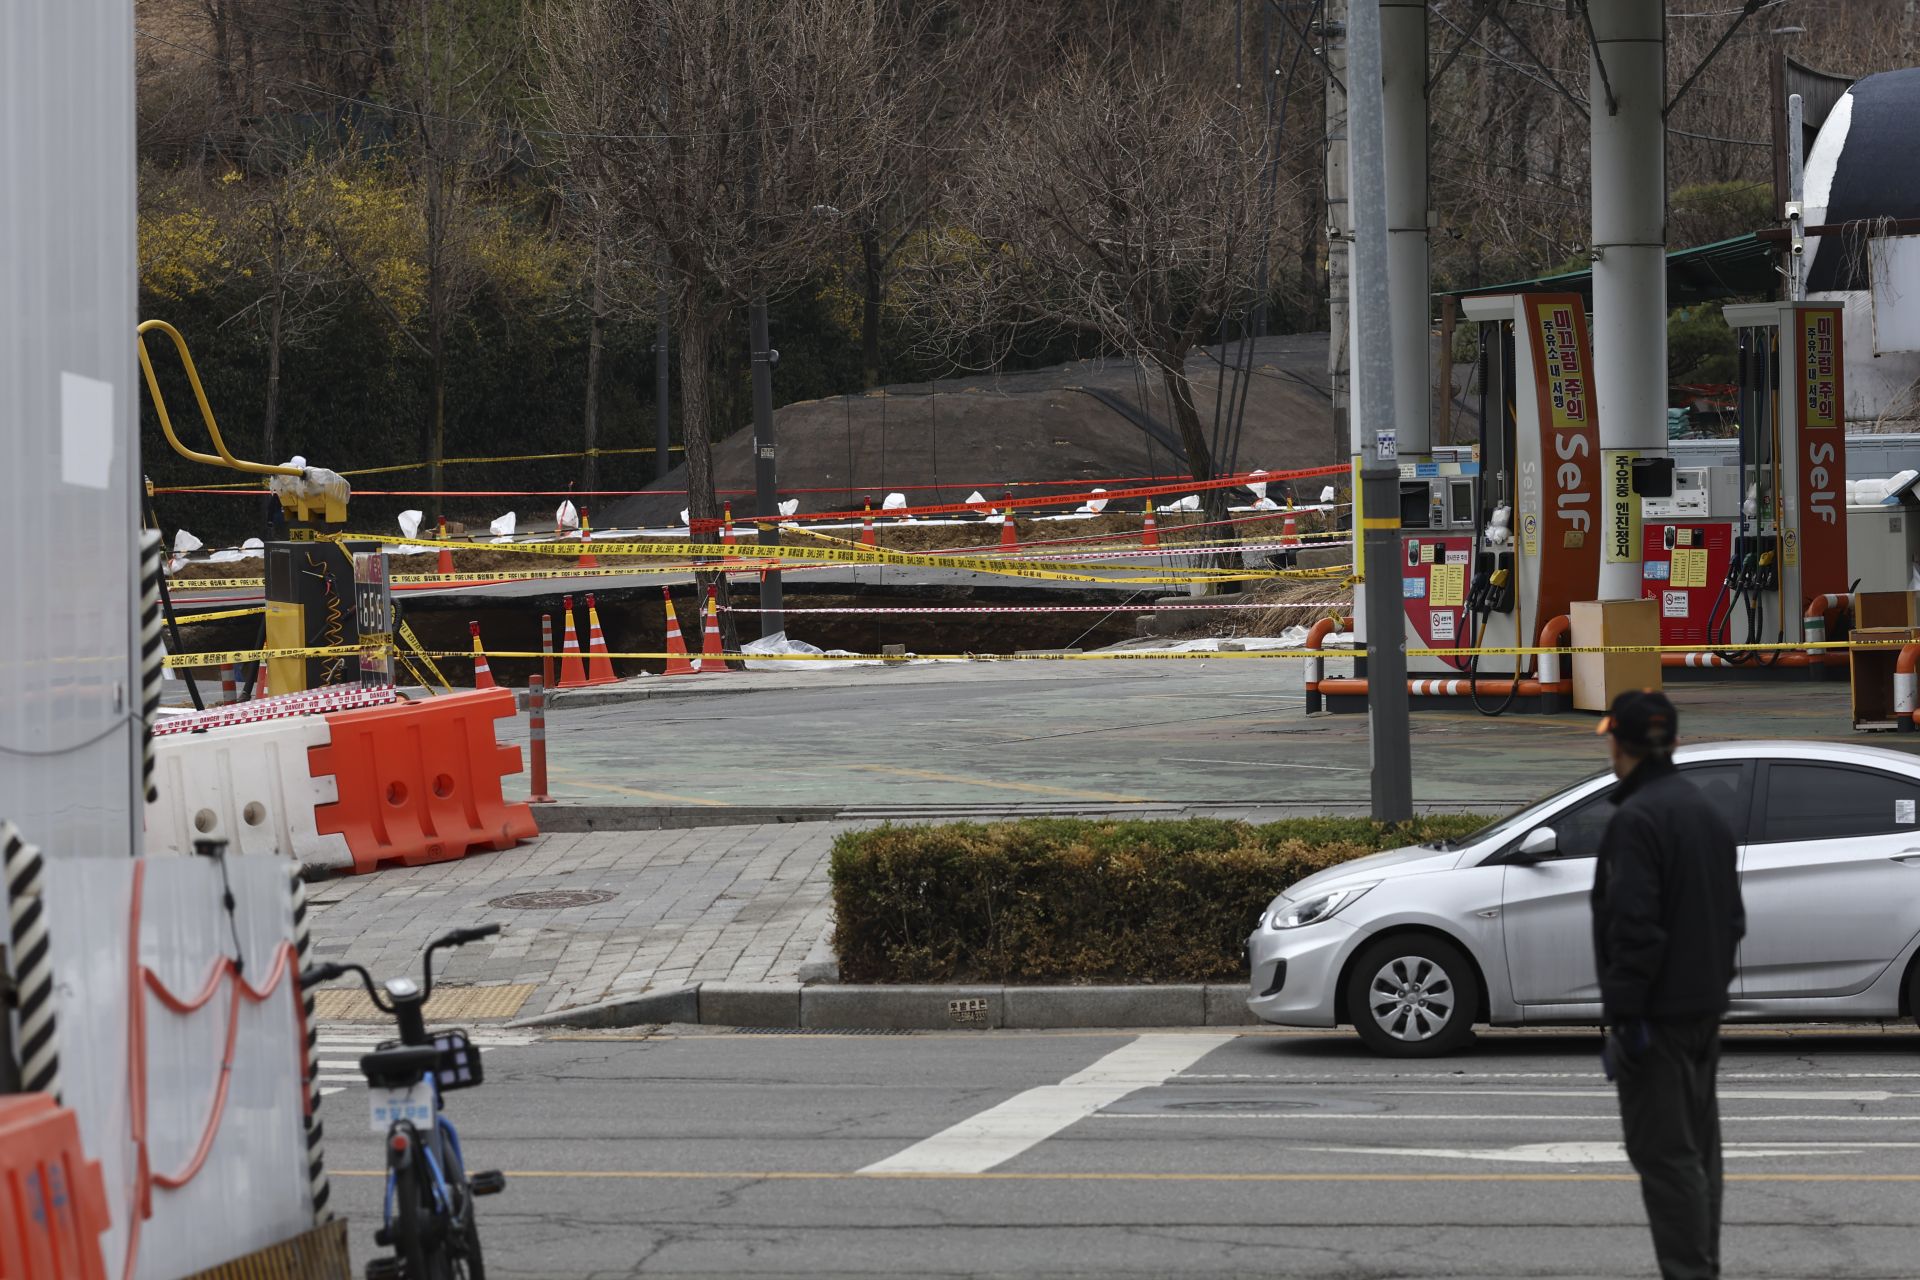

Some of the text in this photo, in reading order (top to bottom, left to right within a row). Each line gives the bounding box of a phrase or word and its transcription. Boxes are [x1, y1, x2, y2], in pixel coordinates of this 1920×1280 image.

[1543, 320, 1564, 409] 주유소 내 서행
[1553, 310, 1584, 420] 미끄럼 주의
[1807, 327, 1817, 364] 주유소
[1808, 368, 1817, 380] 내
[1818, 318, 1833, 419] 미끄럼 주의
[1379, 441, 1395, 455] 7-13
[1555, 433, 1591, 534] Self
[1809, 441, 1837, 526] Self
[1615, 455, 1630, 558] 주유중 엔진정지
[199, 715, 220, 723] DANGER
[284, 703, 305, 712] DANGER
[369, 691, 390, 699] DANGER
